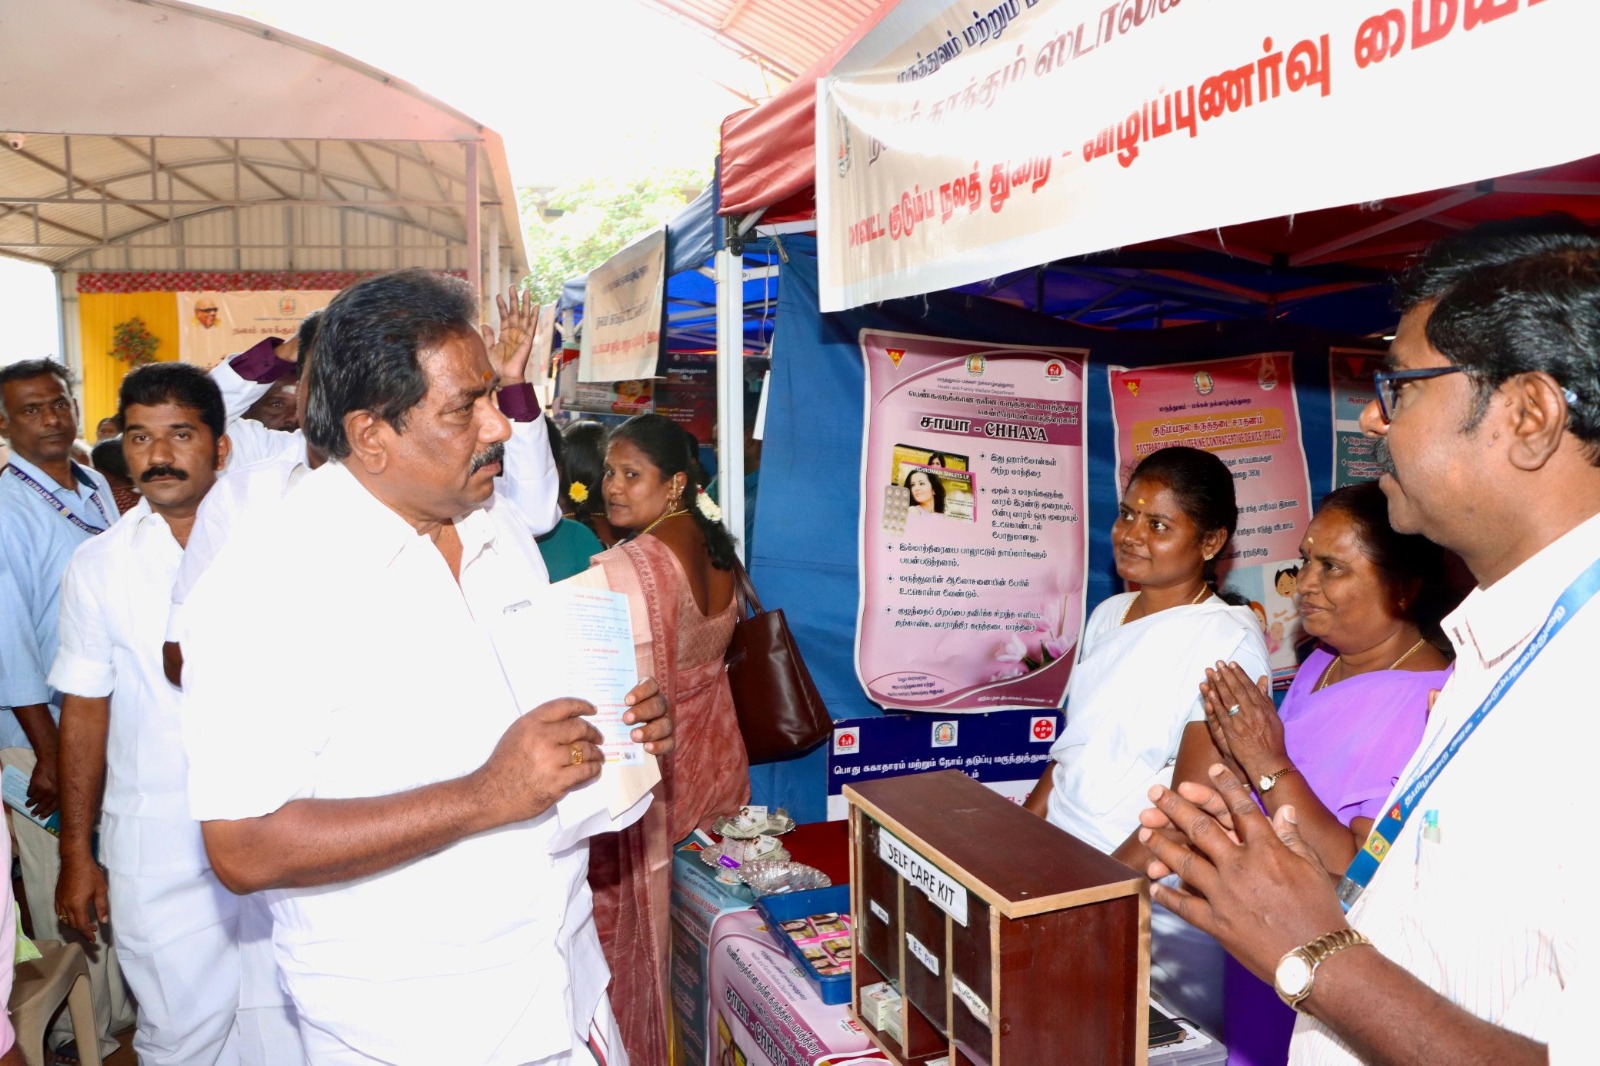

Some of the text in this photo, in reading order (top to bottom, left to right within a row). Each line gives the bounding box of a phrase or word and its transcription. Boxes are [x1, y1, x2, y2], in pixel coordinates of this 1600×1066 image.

[889, 184, 935, 241] குடும்ப
[939, 160, 982, 225] நலத்
[990, 156, 1052, 213] துறை
[1083, 33, 1331, 169] விழிப்புணர்வு
[920, 415, 971, 432] சாயா
[985, 422, 1049, 442] CHHAYA
[25, 478, 61, 509] DEPARTMENT
[834, 764, 861, 776] பொது
[908, 757, 936, 772] மற்றும்
[938, 756, 964, 770] நோய்
[965, 753, 992, 768] தடுப்பு
[888, 843, 955, 906] SELF CARE KIT
[726, 986, 750, 1026] சாயா
